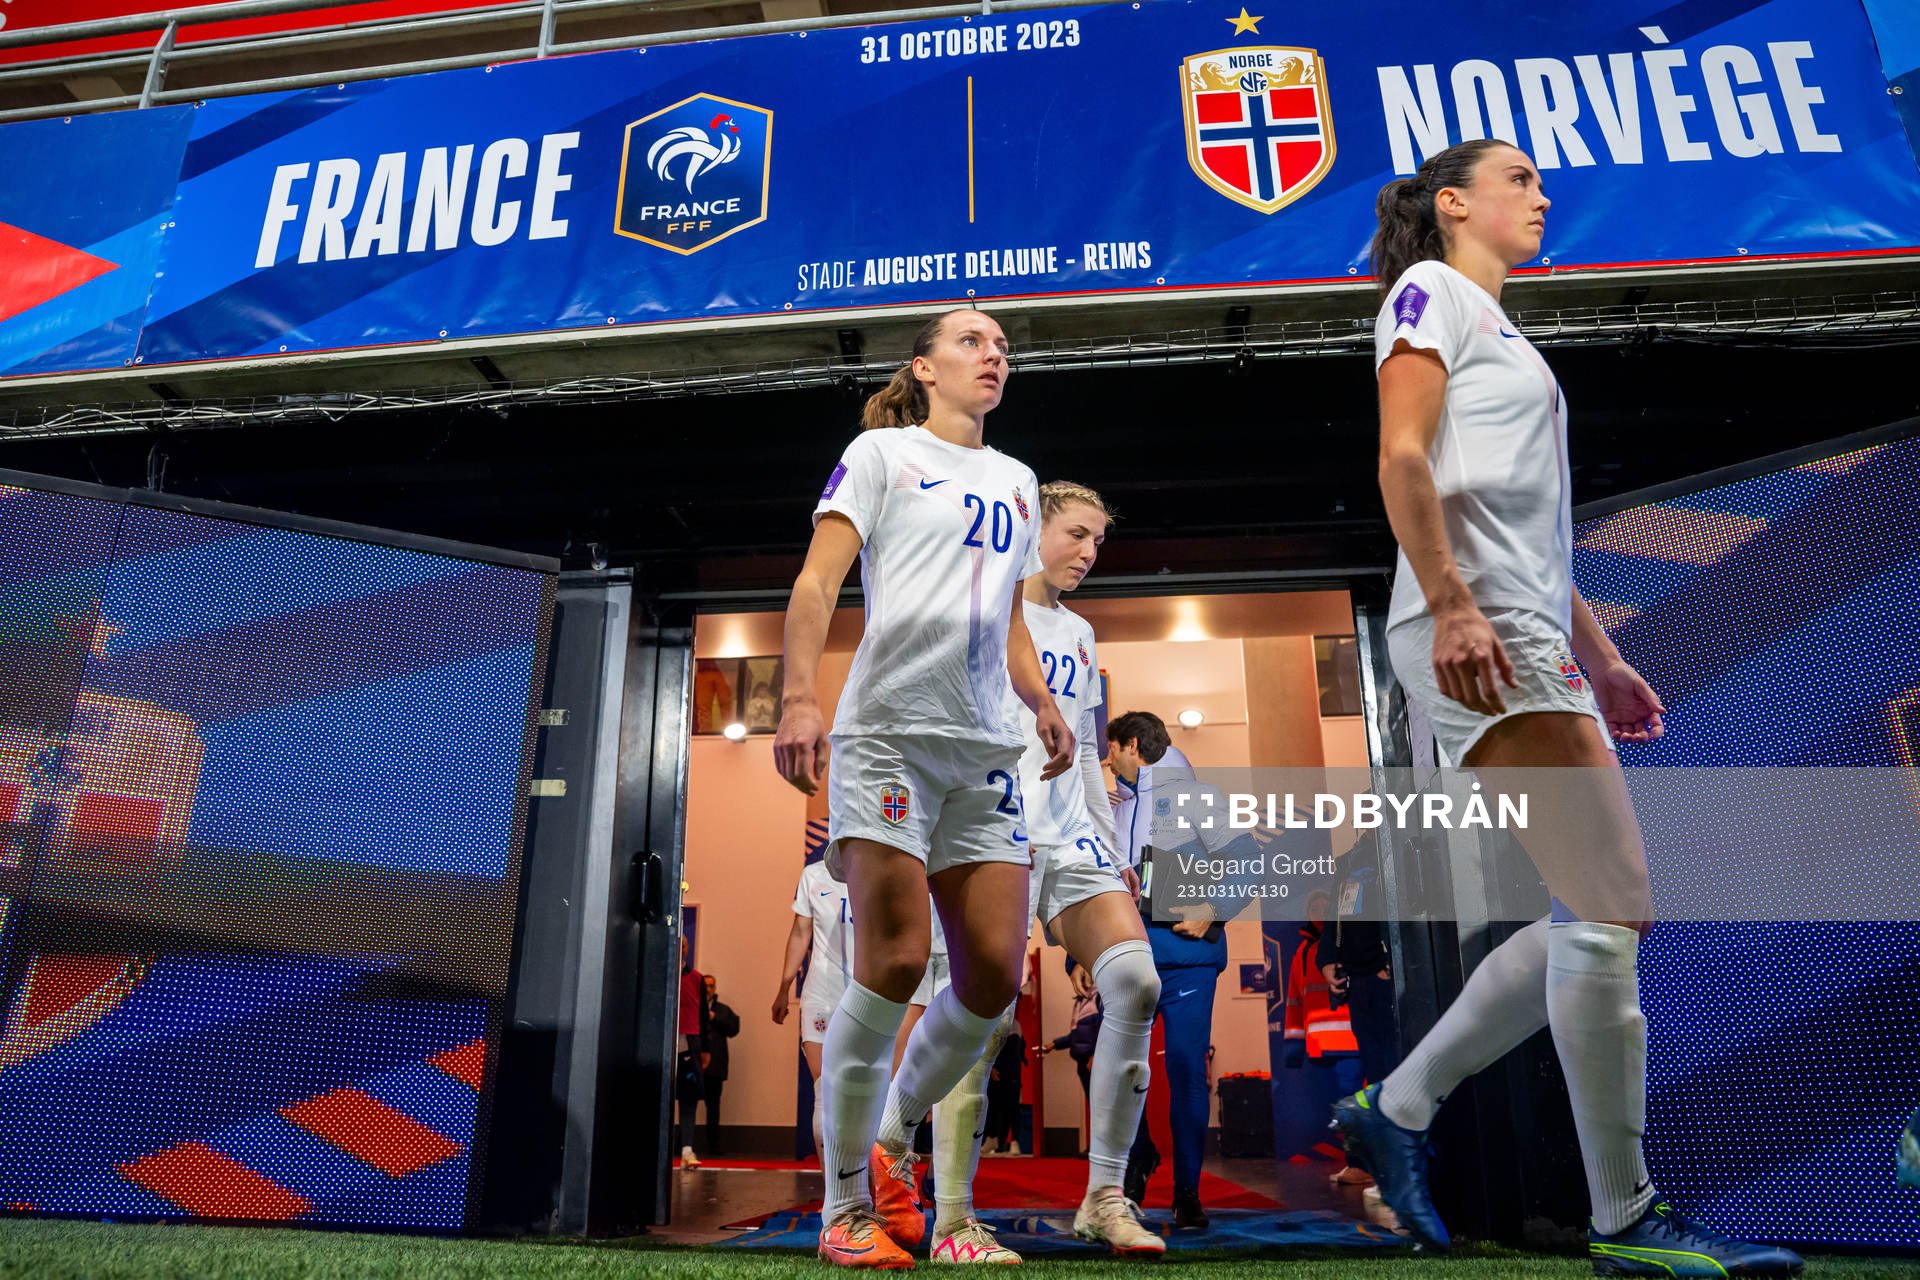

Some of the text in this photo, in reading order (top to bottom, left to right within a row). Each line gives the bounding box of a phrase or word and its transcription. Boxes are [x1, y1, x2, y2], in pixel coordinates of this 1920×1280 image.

[860, 19, 1081, 64] 31 OCTOBRE 2023
[1229, 53, 1273, 69] NORGE
[1376, 26, 1843, 175] NORVÈGE
[254, 131, 580, 268] FRANCE
[640, 197, 741, 221] FRANCE
[666, 220, 712, 235] FFF
[797, 260, 856, 291] STADE
[863, 252, 957, 286] AUGUSTE
[965, 246, 1058, 279] DELAUNE
[1083, 241, 1152, 271] REIMS
[962, 493, 1013, 553] 20
[1042, 650, 1077, 699] 22
[986, 769, 1025, 816] 2
[1075, 835, 1112, 869] 2
